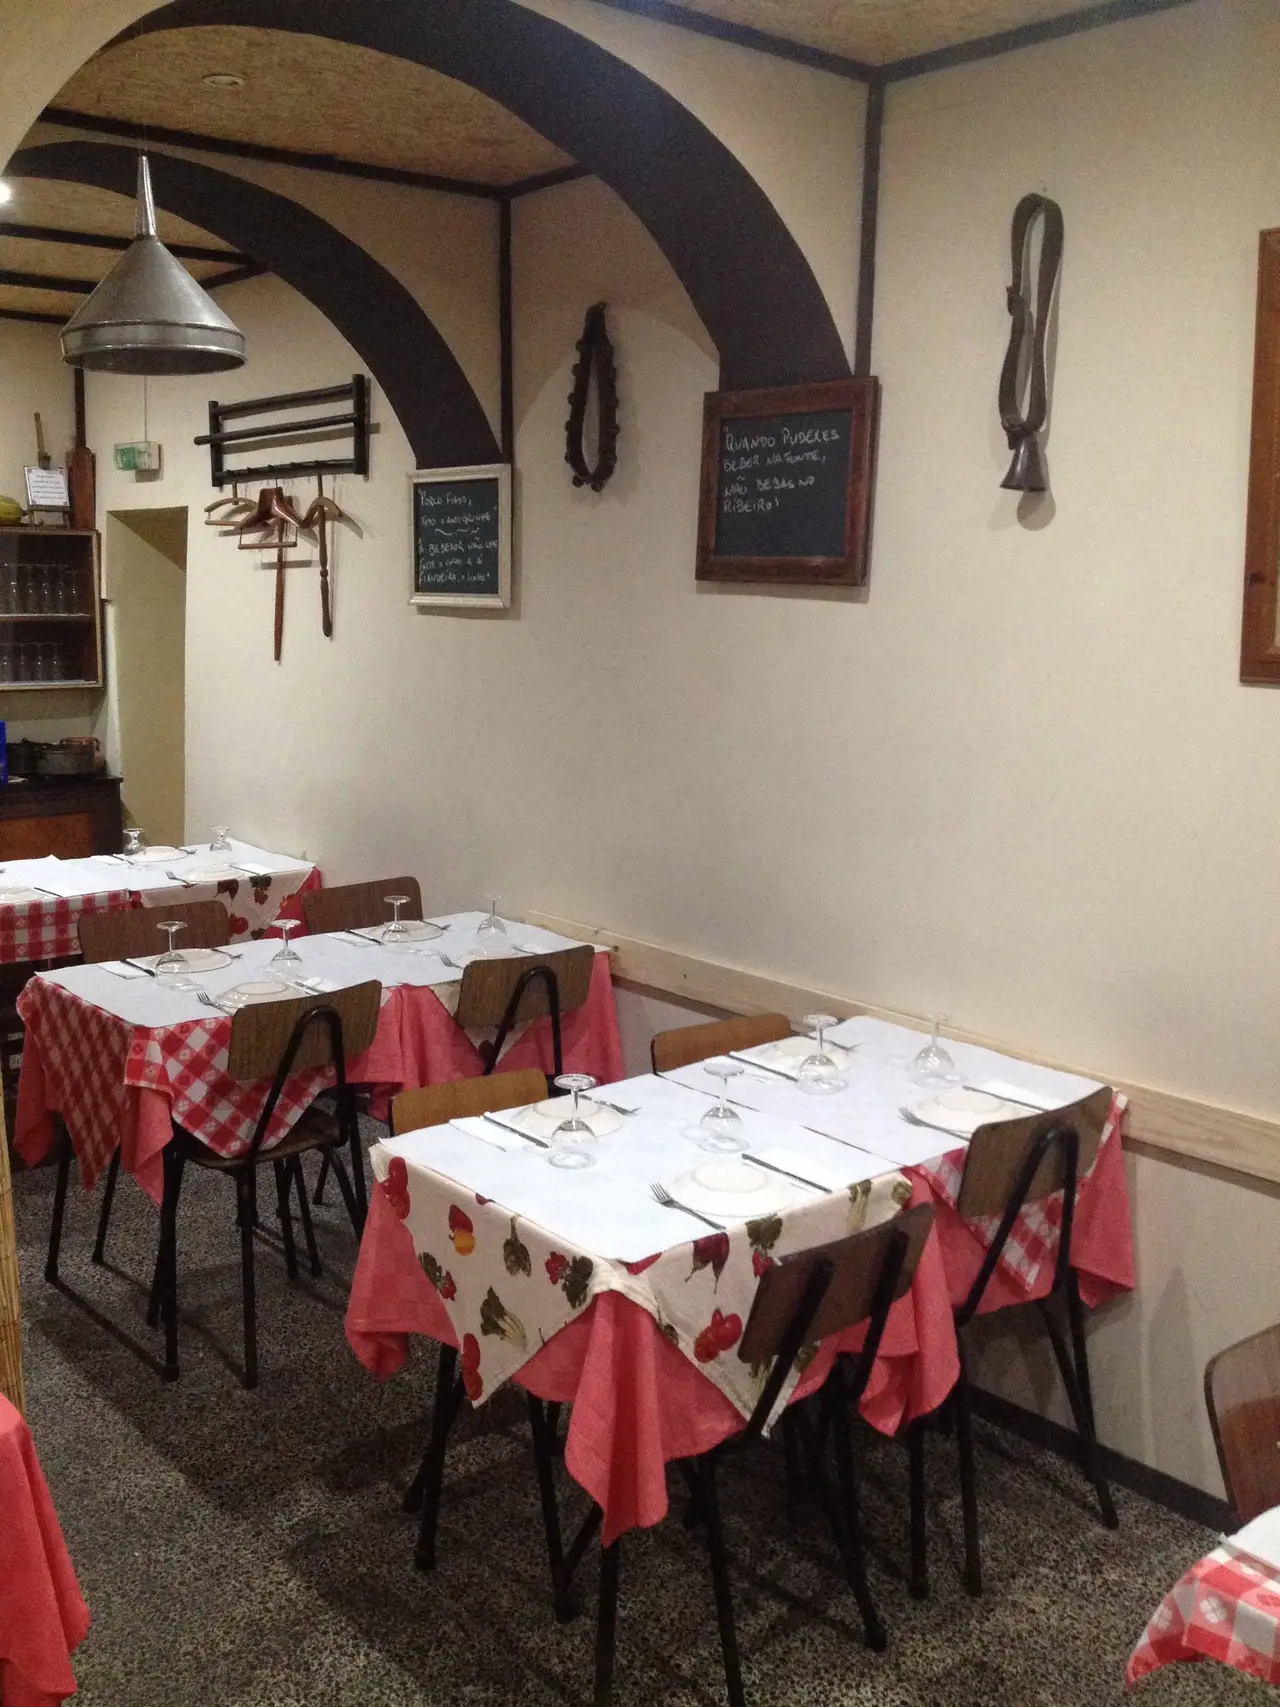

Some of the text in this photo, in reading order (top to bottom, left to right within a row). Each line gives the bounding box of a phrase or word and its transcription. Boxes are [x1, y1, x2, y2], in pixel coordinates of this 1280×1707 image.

[781, 427, 840, 445] PUDERES
[723, 454, 760, 473] BEBER
[765, 453, 782, 466] NA
[724, 475, 816, 497] NÃO BEBAS NO
